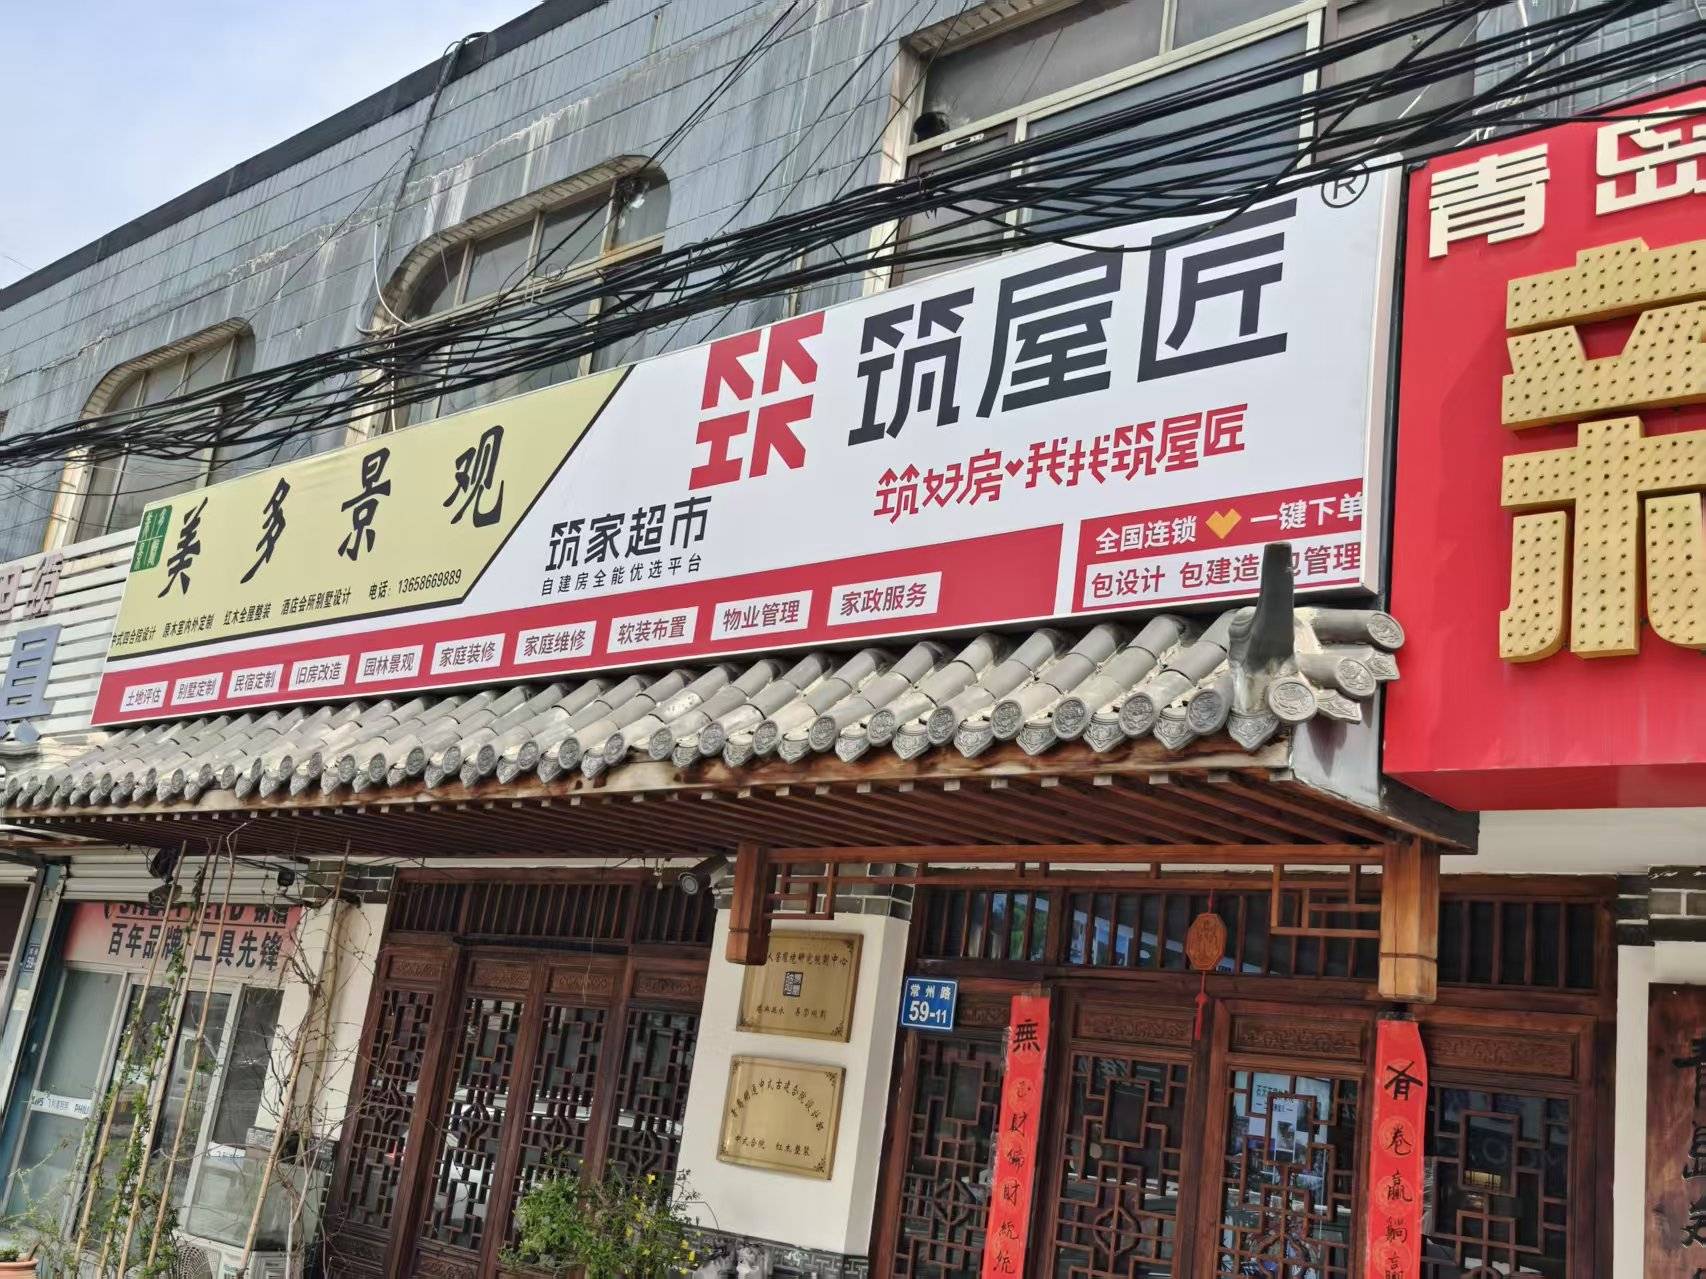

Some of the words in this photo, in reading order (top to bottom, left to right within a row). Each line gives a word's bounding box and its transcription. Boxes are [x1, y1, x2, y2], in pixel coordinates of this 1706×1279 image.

[848, 197, 1297, 447] 筑屋匠
[874, 448, 1003, 524] 筑好房
[544, 495, 712, 571] 筑家超市
[1095, 516, 1198, 555] 全国连锁
[1250, 491, 1362, 531] 一键下单
[280, 587, 352, 616] 酒店会所别墅设计
[398, 568, 462, 595] 13658669889
[541, 552, 702, 597] 自建房全能优选平台
[1091, 565, 1165, 599] 包设计
[1179, 553, 1260, 589] 包建造
[125, 687, 163, 708] 土地评估
[177, 677, 218, 700] 别墅定制
[234, 671, 276, 693] 民宿定制
[296, 661, 342, 685] 旧房改造
[363, 652, 415, 678] 园林景观
[438, 641, 496, 668] 家庭装修
[524, 629, 586, 657] 家庭维修
[616, 615, 687, 646] 软装布置
[723, 599, 800, 632] 物业管理
[840, 583, 928, 616] 家政服务
[108, 922, 184, 961] 百年品牌
[194, 929, 283, 971] 工具先锋
[908, 1000, 948, 1024] 59-11
[910, 984, 951, 1000] 常州路
